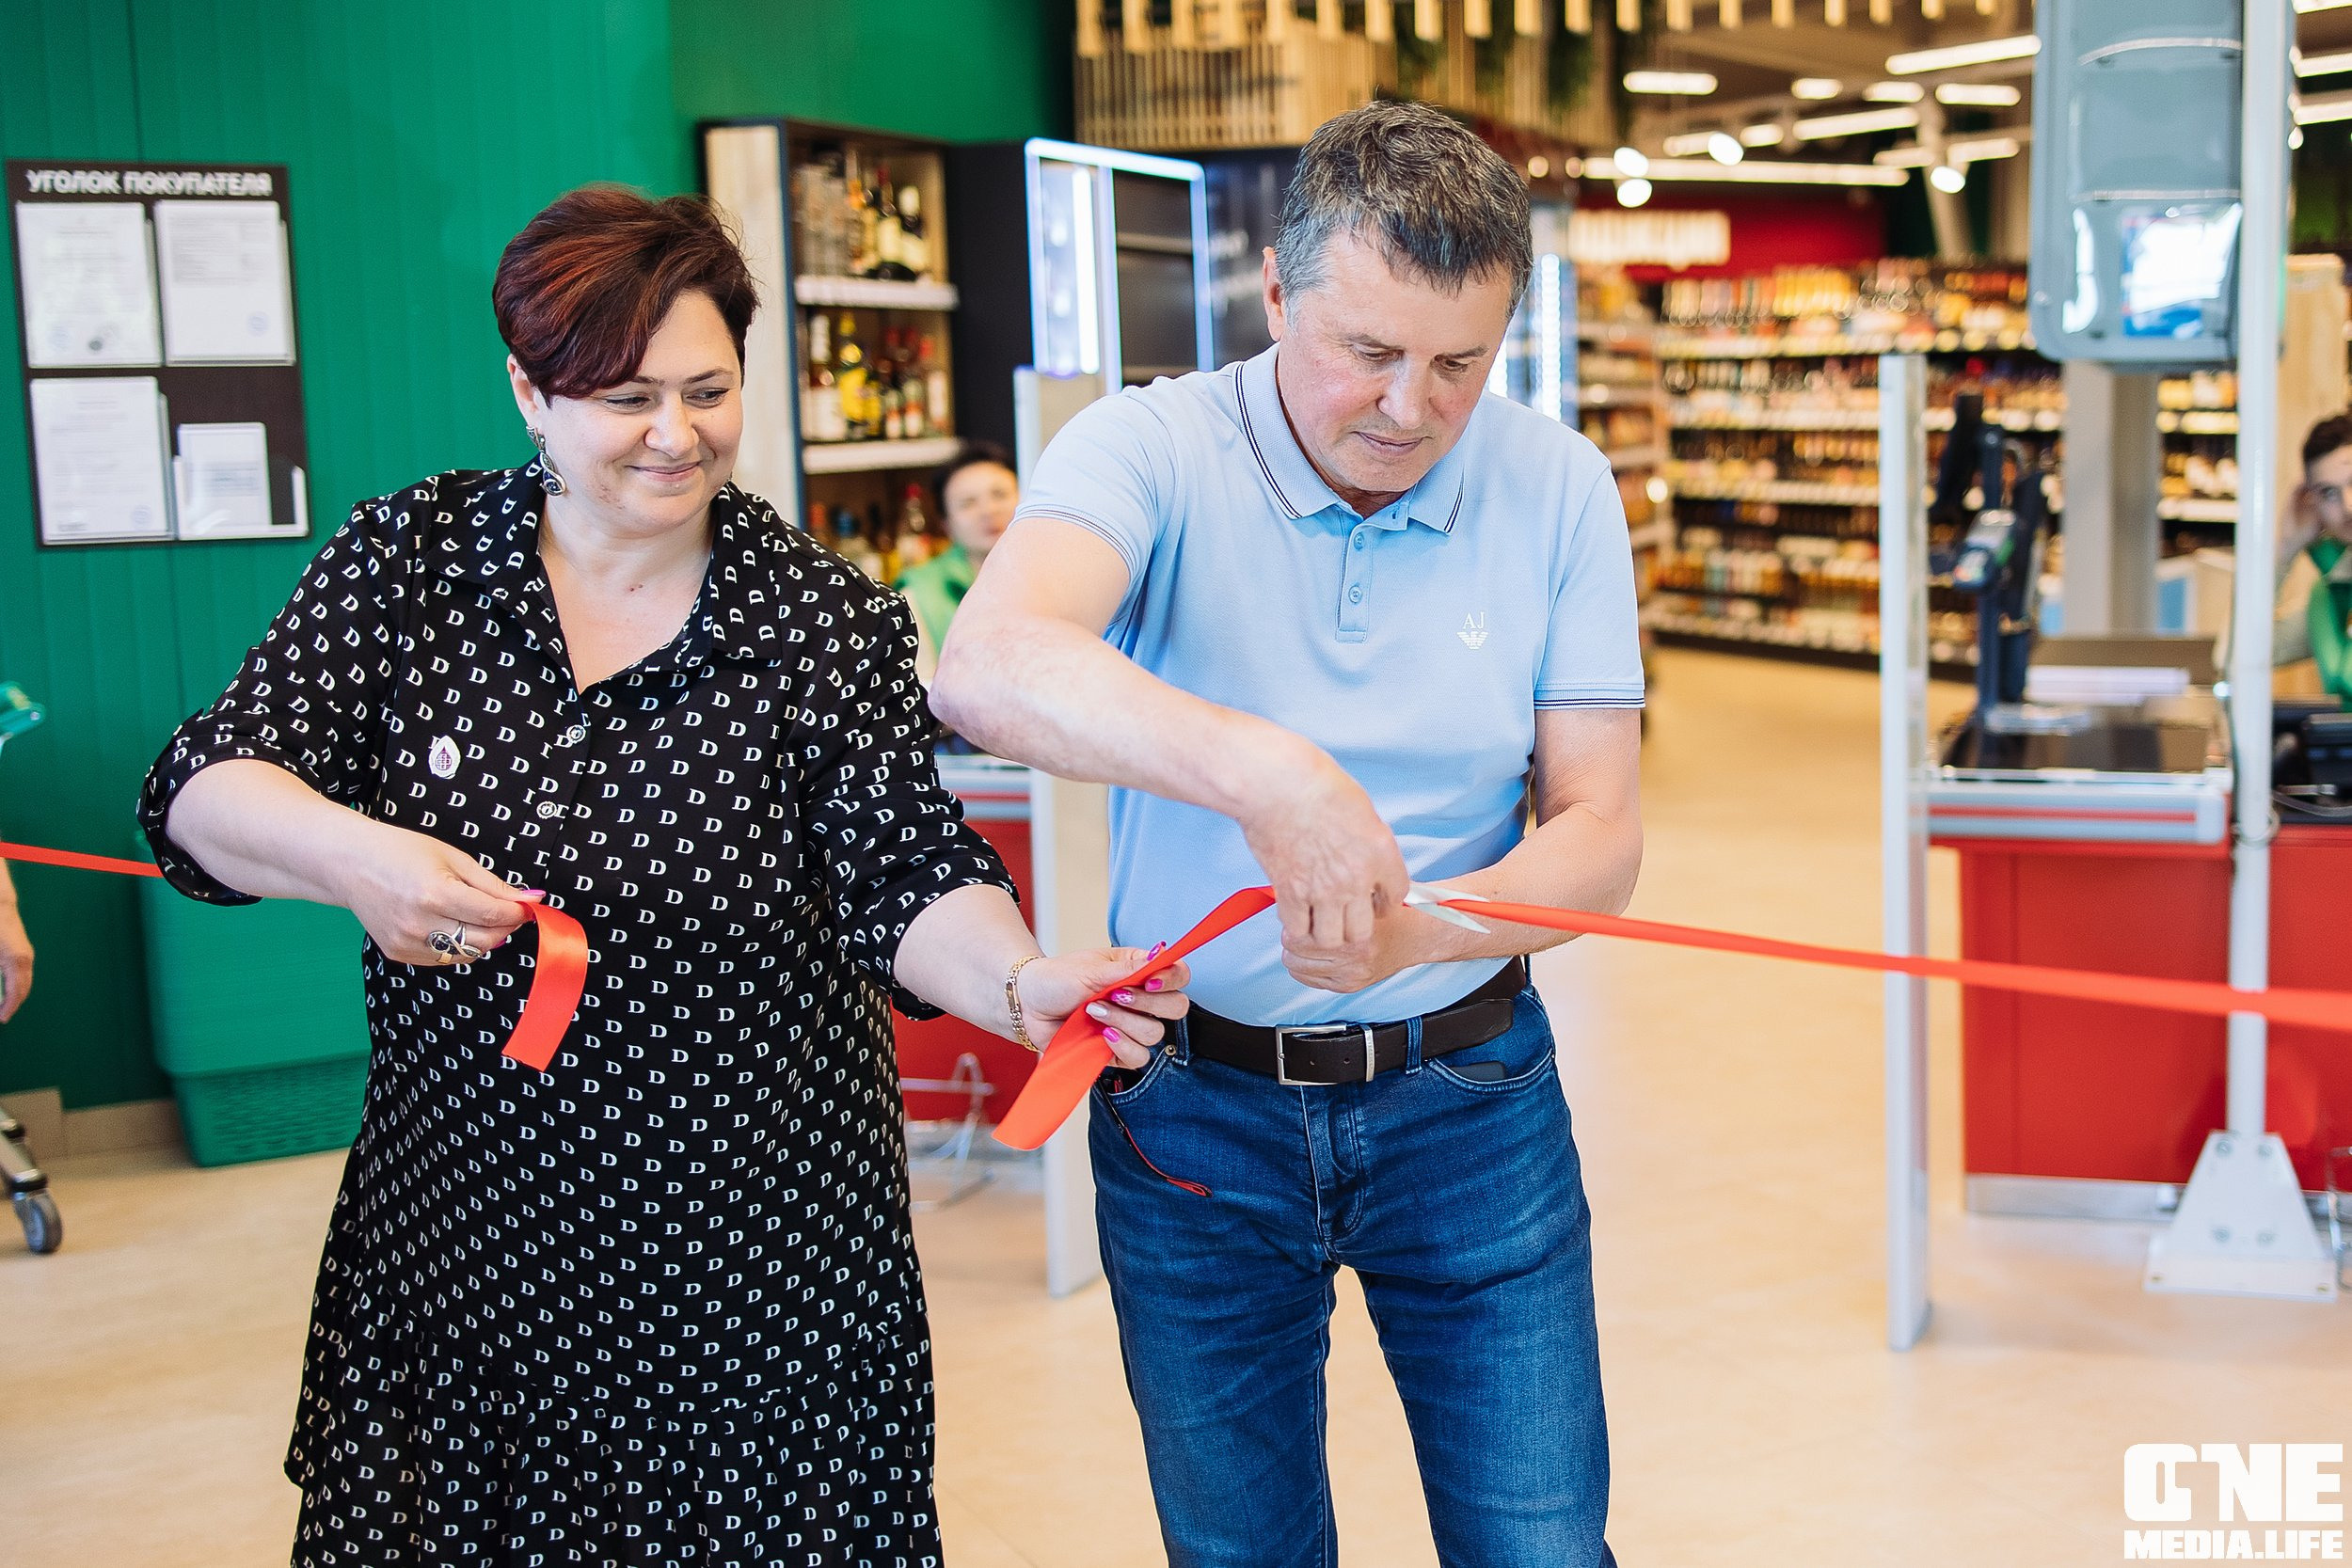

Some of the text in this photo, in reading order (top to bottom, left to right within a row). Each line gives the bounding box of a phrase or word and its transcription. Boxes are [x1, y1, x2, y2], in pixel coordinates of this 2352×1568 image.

[26, 170, 273, 196] УГОЛОК ПОКУПАТЕЛЯ
[374, 505, 391, 524] D
[395, 511, 411, 531] D
[471, 510, 491, 528] D
[520, 511, 538, 530] D
[505, 551, 525, 570] D
[341, 562, 362, 579] D
[444, 562, 466, 578] D
[786, 563, 803, 580] D
[433, 579, 452, 596] D
[339, 593, 359, 612] D
[474, 594, 492, 610] D
[748, 589, 766, 606] D
[729, 607, 745, 625] D
[814, 610, 834, 627] D
[1462, 610, 1486, 629] AJ
[483, 618, 501, 637] D
[848, 631, 866, 651] D
[283, 642, 301, 661] D
[429, 656, 451, 674] D
[796, 656, 815, 673] D
[316, 668, 336, 691] D
[346, 662, 366, 685] D
[405, 666, 423, 687] D
[468, 666, 488, 684] D
[539, 665, 556, 684] D
[626, 673, 644, 687] D
[669, 673, 687, 688] D
[739, 673, 758, 689] D
[511, 679, 532, 697] D
[839, 683, 856, 700] D
[287, 695, 310, 714] D
[592, 690, 612, 708] D
[639, 696, 660, 711] D
[710, 690, 731, 708] D
[351, 700, 368, 721] D
[415, 701, 434, 721] D
[798, 707, 818, 727] D
[526, 709, 545, 729] D
[605, 716, 628, 732] D
[821, 713, 839, 731] D
[257, 723, 278, 742] D
[496, 725, 516, 743] D
[698, 738, 719, 756] D
[855, 733, 873, 751] D
[189, 753, 207, 770] D
[395, 748, 417, 768] D
[586, 759, 608, 775] D
[669, 759, 690, 776] D
[871, 765, 890, 784] D
[537, 776, 559, 794] D
[447, 790, 467, 808] D
[686, 787, 707, 805] D
[731, 795, 752, 812] D
[490, 802, 512, 821] D
[658, 809, 678, 826] D
[767, 802, 784, 819] D
[873, 808, 895, 825] D
[420, 810, 437, 828] D
[460, 820, 480, 839] D
[840, 828, 857, 846] D
[941, 822, 959, 837] D
[558, 844, 579, 862] D
[675, 837, 694, 855] D
[759, 851, 777, 868] D
[691, 866, 712, 883] D
[931, 863, 952, 882] D
[573, 874, 594, 892] D
[664, 888, 684, 905] D
[709, 895, 729, 911] D
[897, 891, 916, 910] D
[591, 903, 611, 918] D
[637, 909, 656, 925] D
[753, 901, 771, 917] D
[681, 916, 701, 931] D
[726, 923, 745, 937] D
[608, 928, 628, 943] D
[871, 924, 887, 944] D
[518, 953, 536, 969] D
[759, 956, 776, 970] D
[495, 972, 514, 988] D
[739, 980, 755, 996] D
[695, 984, 714, 999] D
[798, 992, 814, 1009] D
[456, 1004, 473, 1019] D
[478, 1030, 496, 1044] D
[649, 1023, 668, 1038] D
[584, 1033, 601, 1049] D
[561, 1052, 579, 1068] D
[671, 1048, 690, 1063] D
[581, 1078, 600, 1094] D
[692, 1072, 710, 1086] D
[669, 1095, 688, 1109] D
[712, 1094, 730, 1108] D
[755, 1086, 771, 1102] D
[499, 1099, 516, 1115] D
[602, 1104, 621, 1120] D
[519, 1125, 536, 1141] D
[579, 1125, 596, 1141] D
[623, 1132, 642, 1148] D
[711, 1139, 729, 1153] D
[539, 1151, 556, 1168] D
[599, 1151, 618, 1166] D
[644, 1158, 662, 1172] D
[796, 1160, 812, 1176] D
[782, 1188, 799, 1203] D
[579, 1207, 595, 1223] D
[620, 1218, 638, 1232] D
[727, 1229, 744, 1246] D
[786, 1232, 802, 1247] D
[686, 1240, 703, 1255] D
[620, 1258, 637, 1272] D
[766, 1259, 783, 1275] D
[598, 1271, 615, 1286] D
[834, 1267, 850, 1285] D
[520, 1280, 536, 1296] D
[640, 1281, 658, 1295] D
[618, 1296, 635, 1311] D
[705, 1300, 723, 1315] D
[819, 1298, 835, 1316] D
[537, 1307, 554, 1323] D
[516, 1321, 532, 1337] D
[556, 1335, 572, 1350] D
[745, 1331, 762, 1347] D
[803, 1330, 819, 1347] D
[723, 1358, 741, 1372] D
[786, 1359, 803, 1376] D
[345, 1366, 361, 1383] D
[552, 1374, 569, 1388] D
[745, 1373, 762, 1387] D
[593, 1386, 610, 1400] D
[634, 1396, 651, 1410] D
[366, 1421, 384, 1436] D
[610, 1416, 626, 1430] D
[814, 1413, 831, 1430] D
[884, 1422, 900, 1437] D
[580, 1430, 597, 1444] D
[740, 1440, 756, 1457] D
[358, 1465, 375, 1480] D
[796, 1462, 813, 1477] D
[626, 1481, 643, 1495] D
[706, 1490, 723, 1505] D
[646, 1499, 662, 1514] D
[530, 1511, 547, 1525] D
[724, 1514, 741, 1529] D
[913, 1513, 929, 1528] D
[787, 1532, 803, 1547] D
[645, 1542, 661, 1557] D
